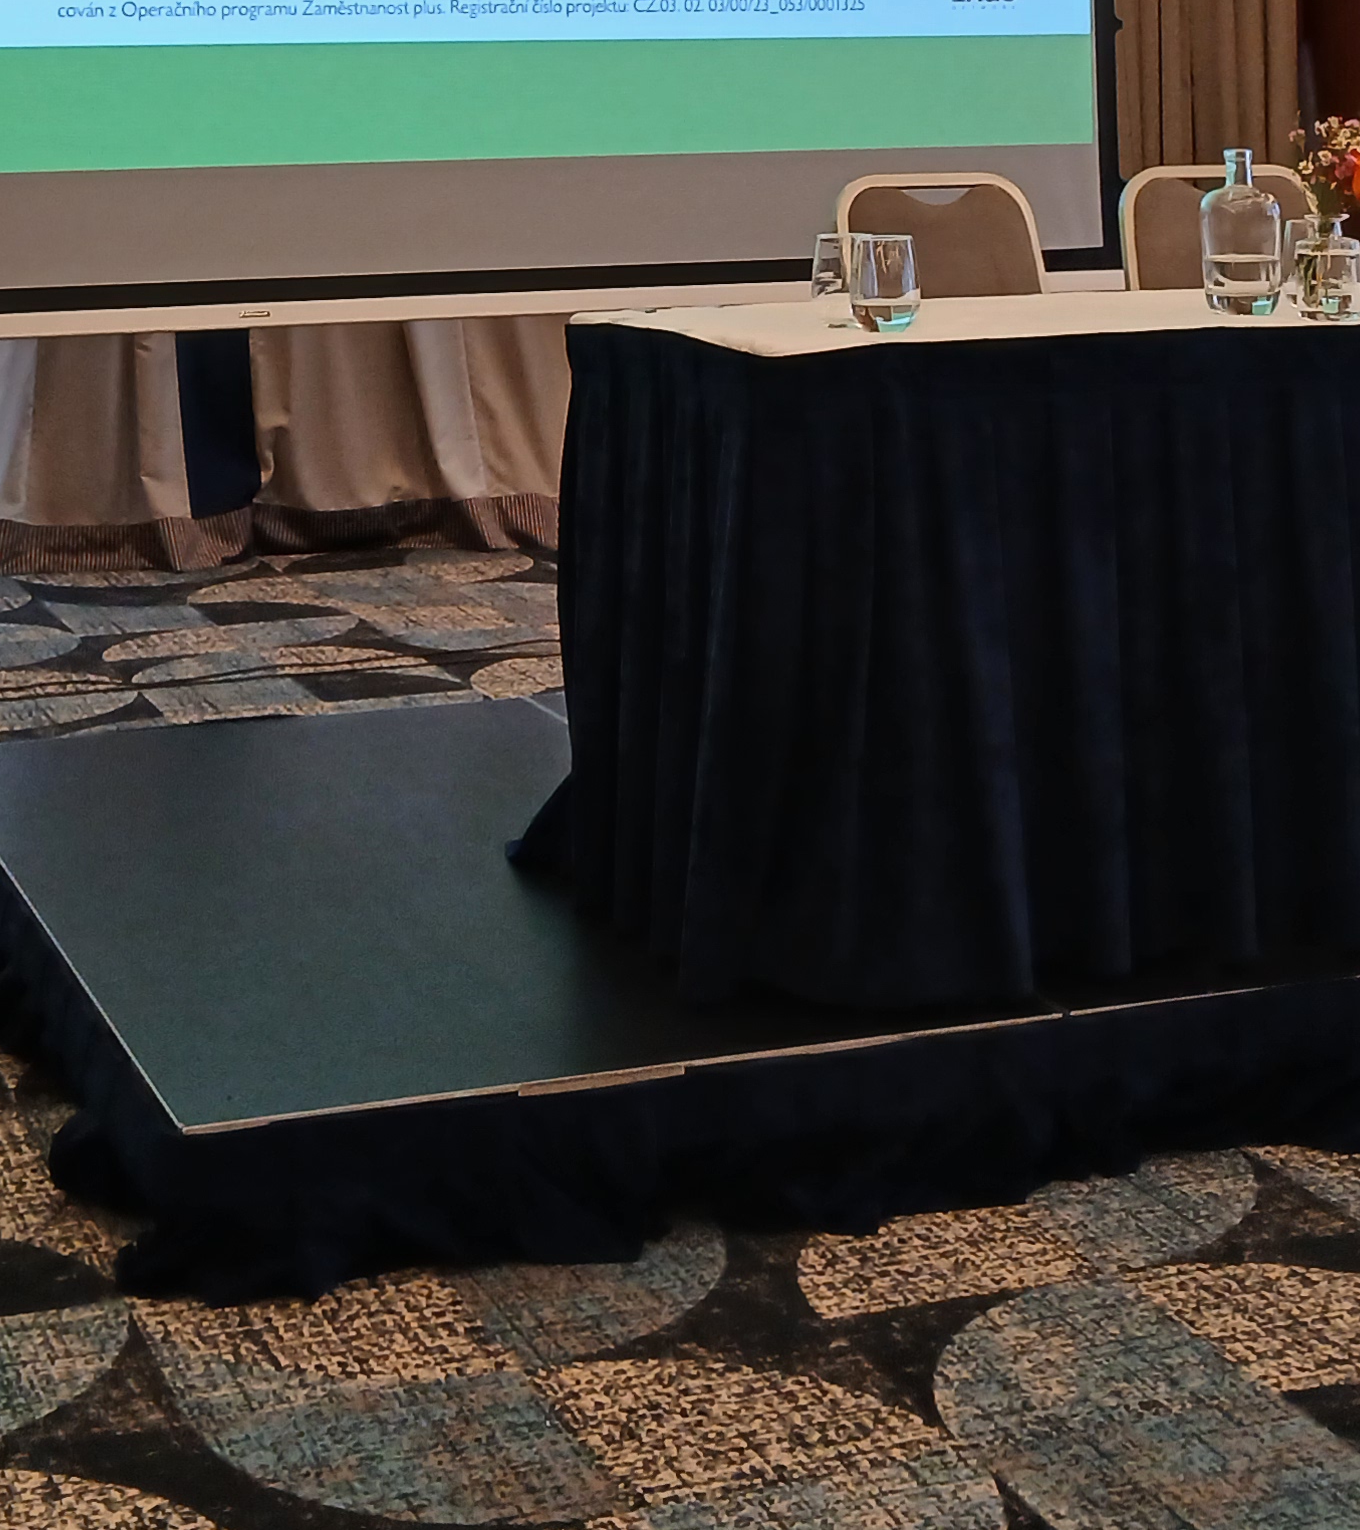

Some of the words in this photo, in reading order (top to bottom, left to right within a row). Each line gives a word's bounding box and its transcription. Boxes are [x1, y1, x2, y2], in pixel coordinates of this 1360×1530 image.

[57, 1, 105, 18] cován
[109, 6, 116, 17] z
[122, 1, 216, 21] Operačního
[222, 5, 297, 21] programu
[302, 0, 409, 15] Zaměstnanost
[451, 0, 529, 18] Registrační
[532, 0, 562, 13] číslo
